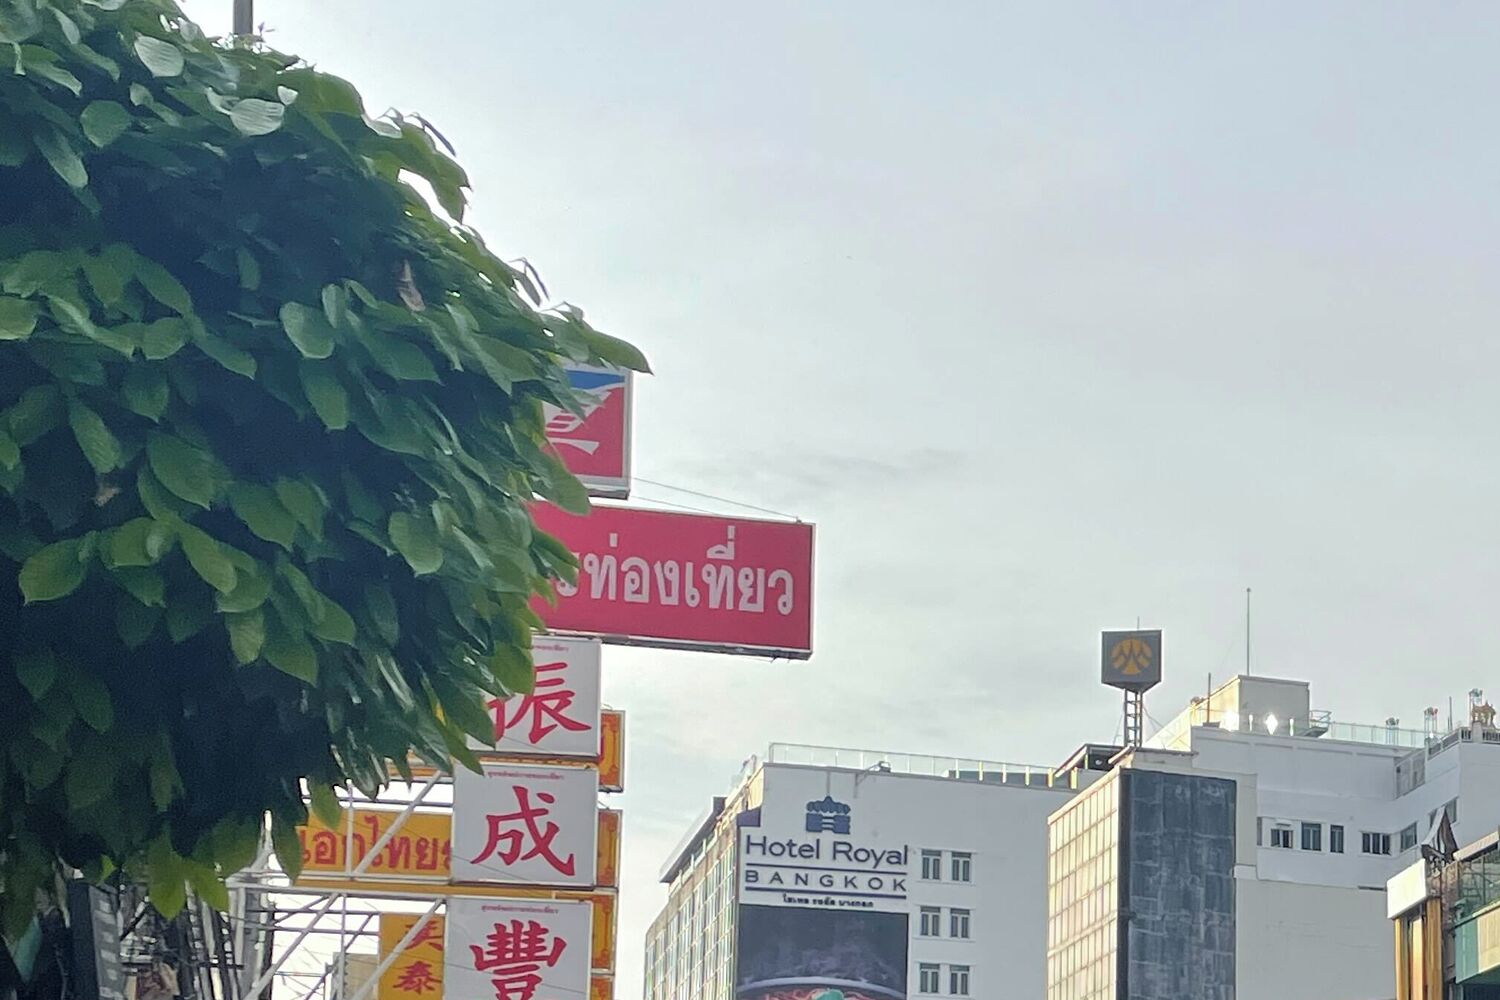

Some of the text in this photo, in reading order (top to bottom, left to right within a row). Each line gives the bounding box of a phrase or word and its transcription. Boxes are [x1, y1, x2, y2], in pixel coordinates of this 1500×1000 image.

[470, 785, 575, 876] 成
[746, 835, 908, 869] Hotel Royal
[745, 870, 907, 892] BANGKOK
